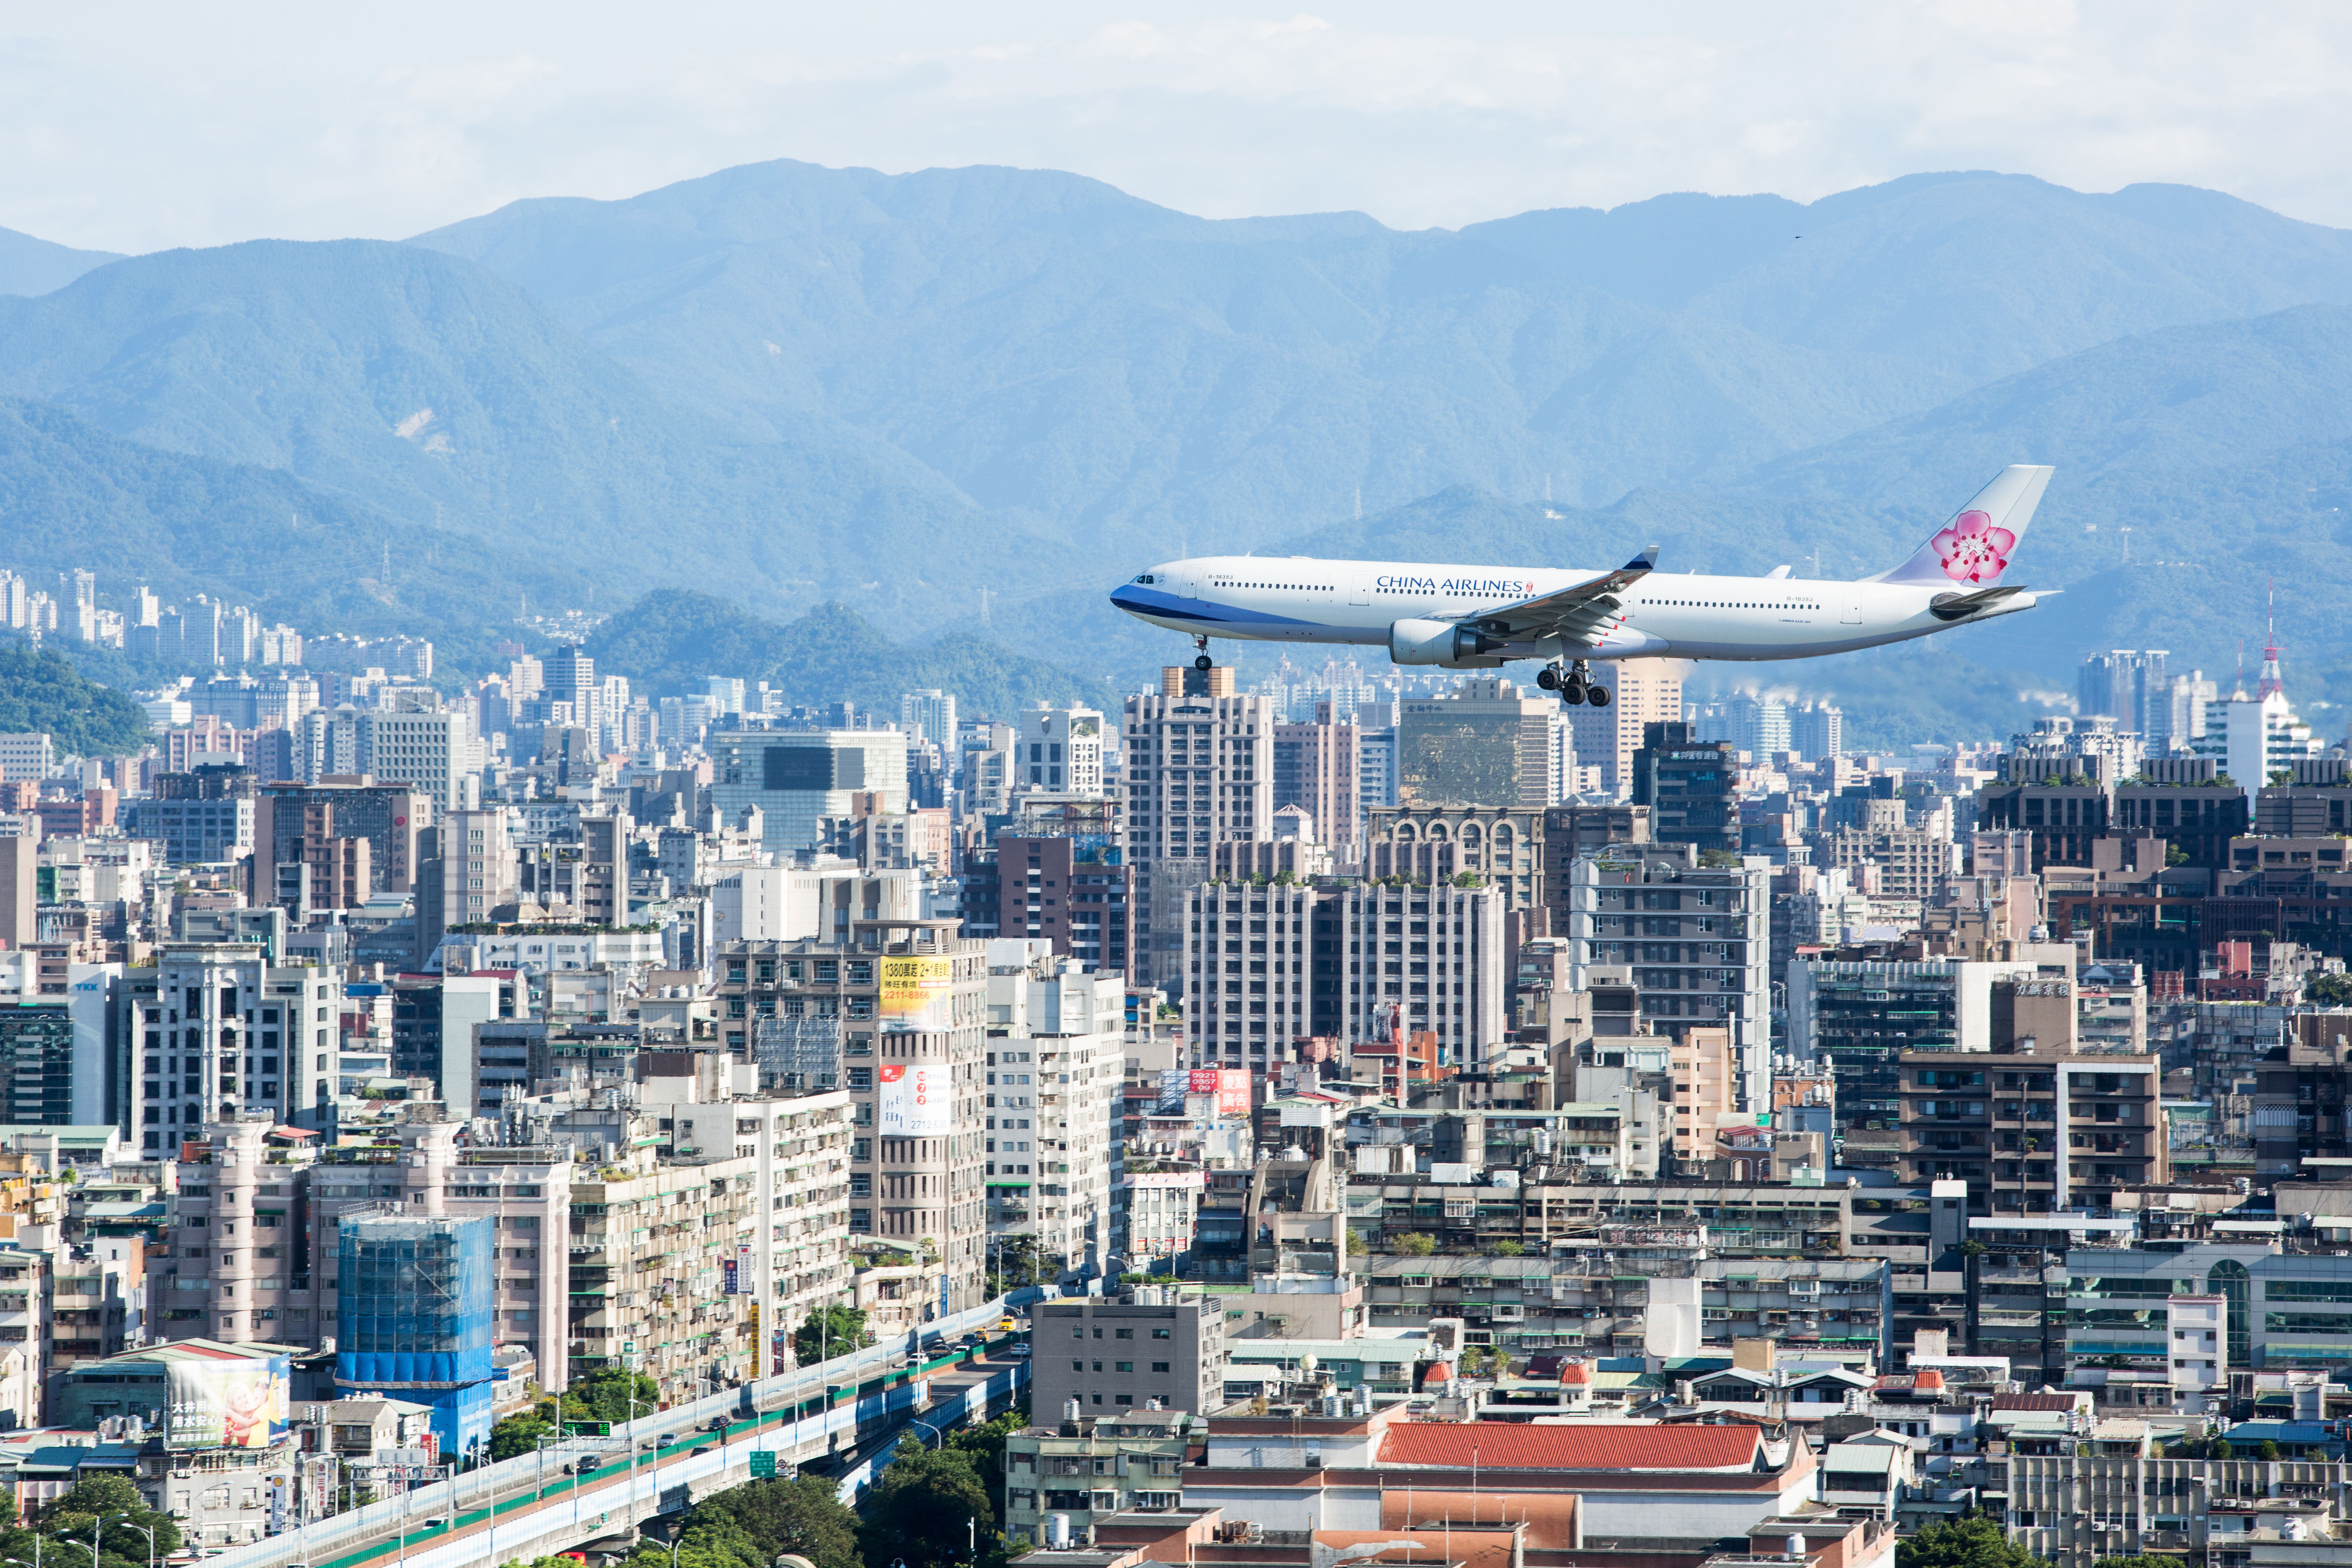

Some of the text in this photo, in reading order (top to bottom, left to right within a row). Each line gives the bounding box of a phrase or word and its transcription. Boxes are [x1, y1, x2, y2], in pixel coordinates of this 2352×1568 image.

[1377, 576, 1435, 588] CHINA
[1440, 578, 1522, 592] AIRLINES
[1407, 705, 1443, 713] 金融中心
[885, 963, 917, 977] 1380萬起
[884, 991, 930, 999] 2211-8866
[1222, 1075, 1247, 1089] 優點
[1222, 1093, 1247, 1107] 廣告
[172, 1401, 218, 1414] 大井用心
[172, 1415, 218, 1427] 用水安心
